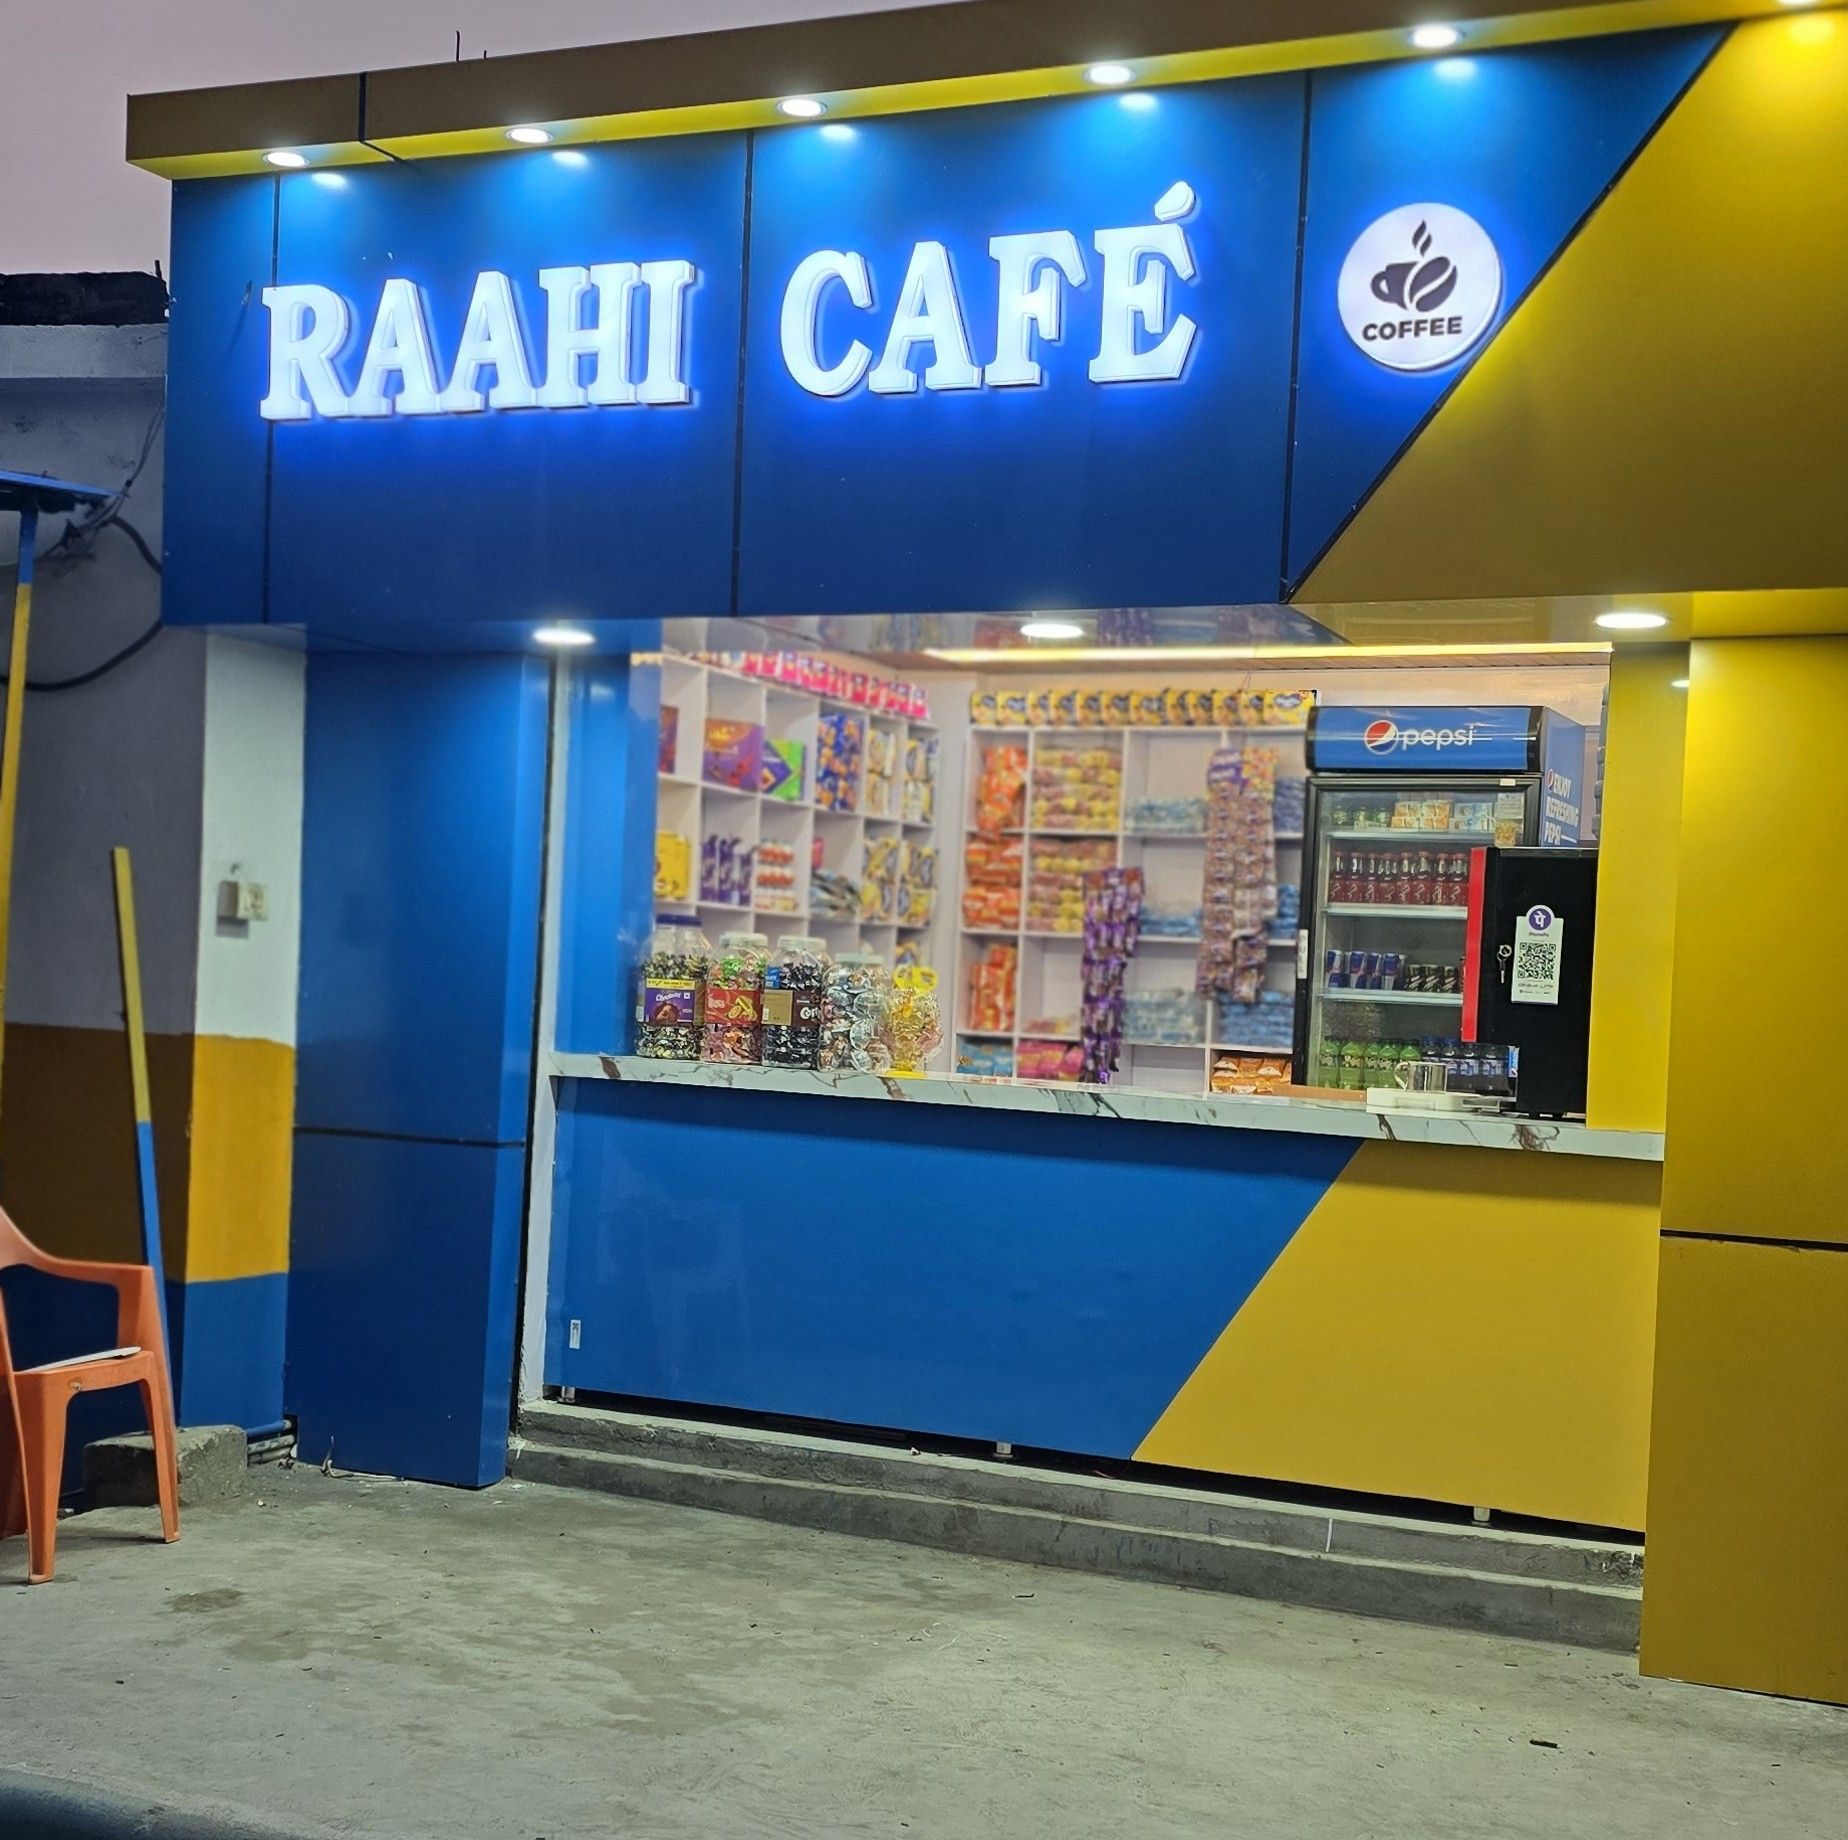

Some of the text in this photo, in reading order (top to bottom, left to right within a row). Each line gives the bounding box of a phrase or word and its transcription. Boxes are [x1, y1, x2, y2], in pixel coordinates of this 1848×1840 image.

[259, 180, 1197, 420] RAAHI CAFÉ
[1362, 316, 1463, 341] COFFEE
[1402, 725, 1474, 751] pepsi
[1553, 772, 1572, 799] ENJOY
[1545, 796, 1579, 828] REFRESHING
[1543, 821, 1562, 846] PEPSI
